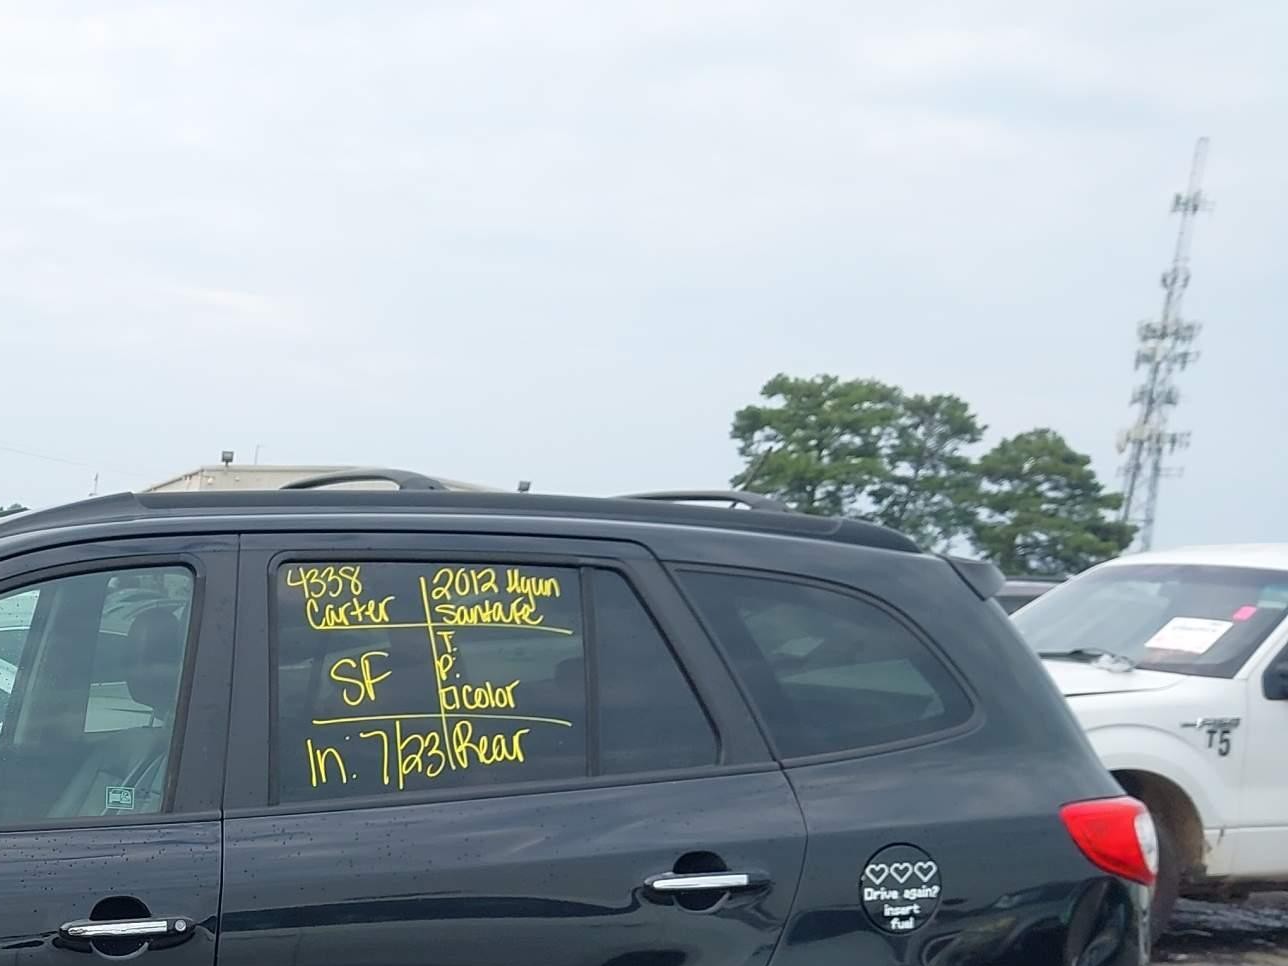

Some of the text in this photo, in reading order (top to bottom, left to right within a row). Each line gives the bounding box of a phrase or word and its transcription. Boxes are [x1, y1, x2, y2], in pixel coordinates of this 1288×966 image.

[287, 566, 362, 598] 4338
[431, 568, 499, 600] 2012
[307, 596, 395, 629] Carter
[331, 652, 392, 706] SF
[453, 720, 530, 769] Rear
[864, 885, 940, 901] Drive again?
